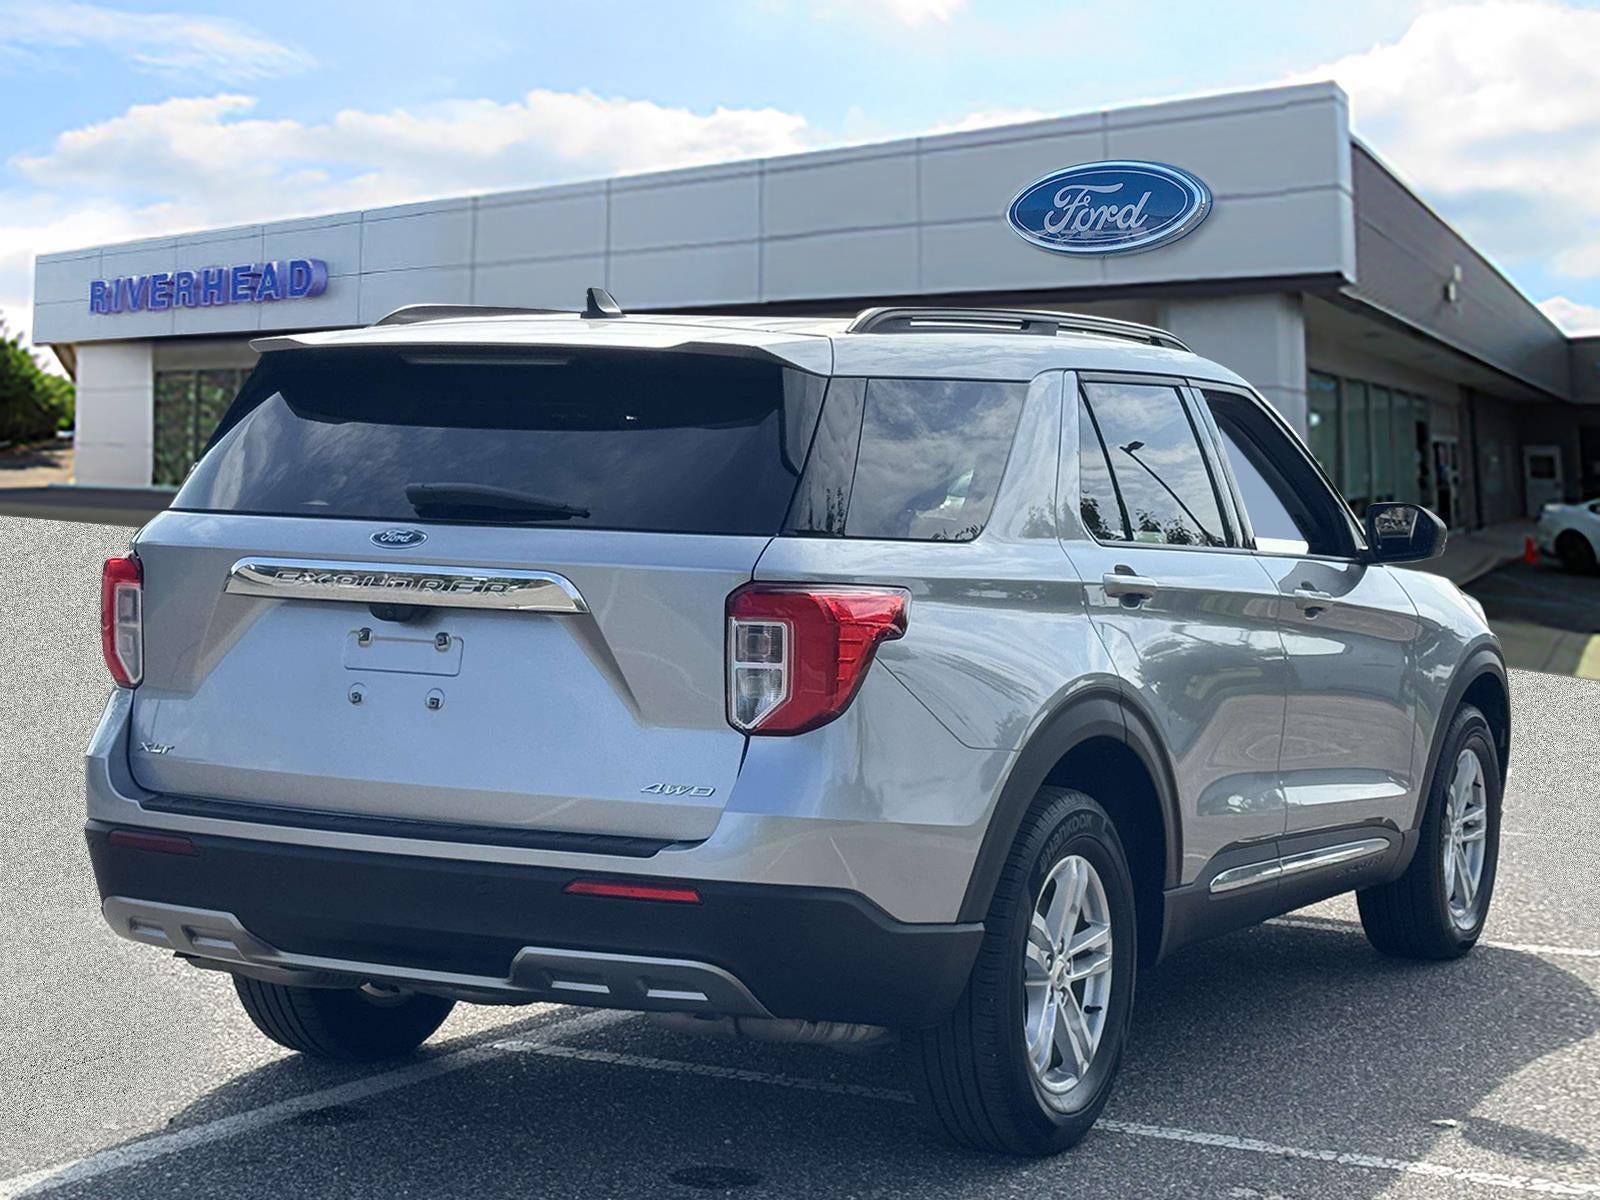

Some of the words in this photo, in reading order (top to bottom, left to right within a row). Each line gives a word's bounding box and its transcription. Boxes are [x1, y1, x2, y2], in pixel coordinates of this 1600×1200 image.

[1044, 183, 1152, 233] Ford
[88, 258, 320, 314] RIVERHEAD
[380, 530, 414, 542] Ford
[271, 570, 509, 596] EXPLORER
[137, 742, 175, 754] XLT
[640, 782, 716, 797] 4WD
